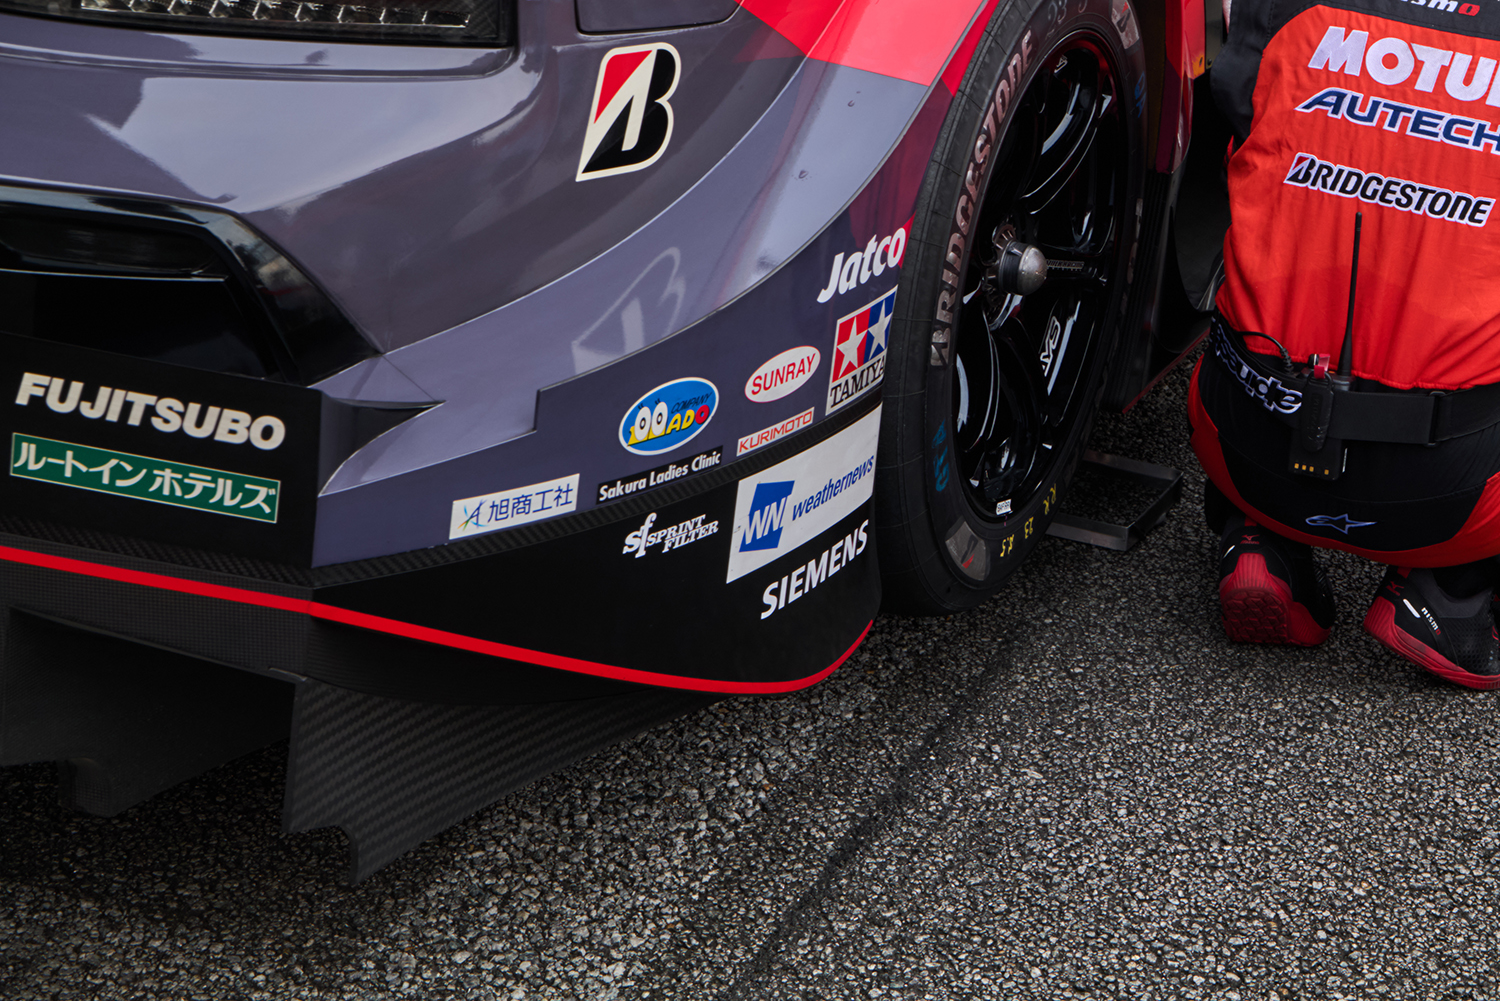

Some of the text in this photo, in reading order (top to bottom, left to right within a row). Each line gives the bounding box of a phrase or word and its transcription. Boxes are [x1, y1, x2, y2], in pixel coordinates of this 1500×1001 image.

[931, 30, 1032, 366] BRIDGESTONE
[1284, 152, 1496, 227] BRIDGESTONE
[817, 225, 907, 303] Jatco
[751, 353, 816, 395] SUNRAY
[830, 357, 886, 408] TAMIYA
[15, 372, 286, 450] FUJITSUBO
[671, 392, 713, 415] COMPANY
[739, 410, 813, 454] KURIMOTO
[488, 483, 574, 521] 旭商工社
[599, 451, 721, 502] Sakura Ladies Clinic
[791, 454, 875, 522] weathernews
[646, 514, 706, 547] SPRINT
[662, 519, 719, 553] FILTER
[761, 519, 869, 620] SIEMENS
[1421, 607, 1441, 636] nismo
